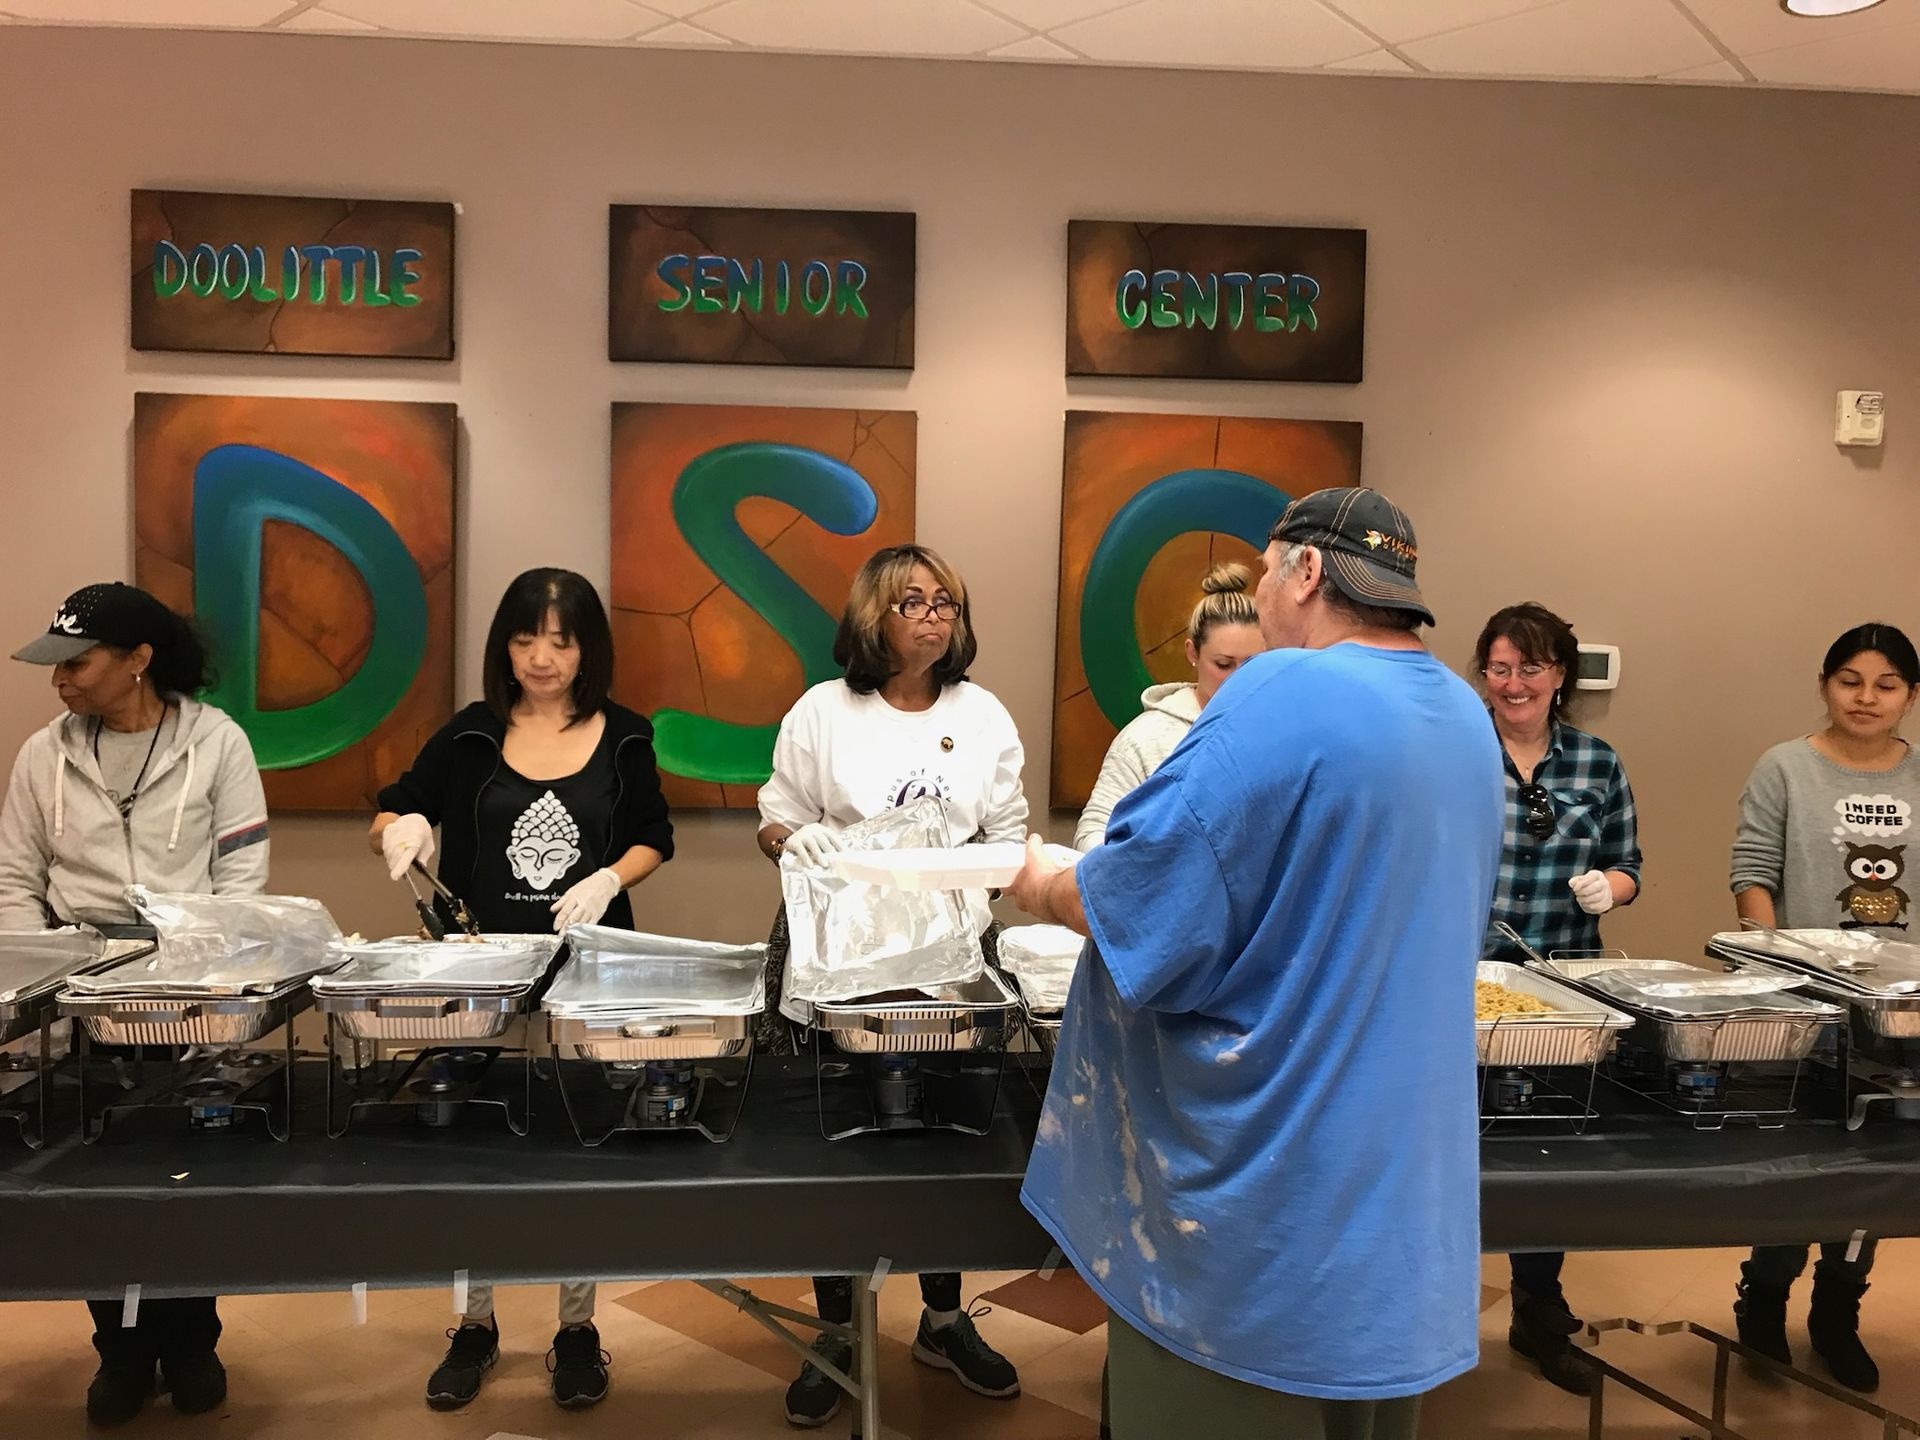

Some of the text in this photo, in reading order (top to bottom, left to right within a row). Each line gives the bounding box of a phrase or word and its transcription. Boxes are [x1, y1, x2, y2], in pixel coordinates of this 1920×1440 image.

[154, 240, 422, 306] DOOLITTLE
[656, 254, 869, 318] SENIOR
[1115, 269, 1321, 333] CENTER
[1381, 531, 1420, 560] VIKIN
[193, 443, 427, 770] D
[651, 441, 878, 785] S
[1845, 802, 1897, 814] I NEED
[1845, 813, 1903, 826] COFFEE
